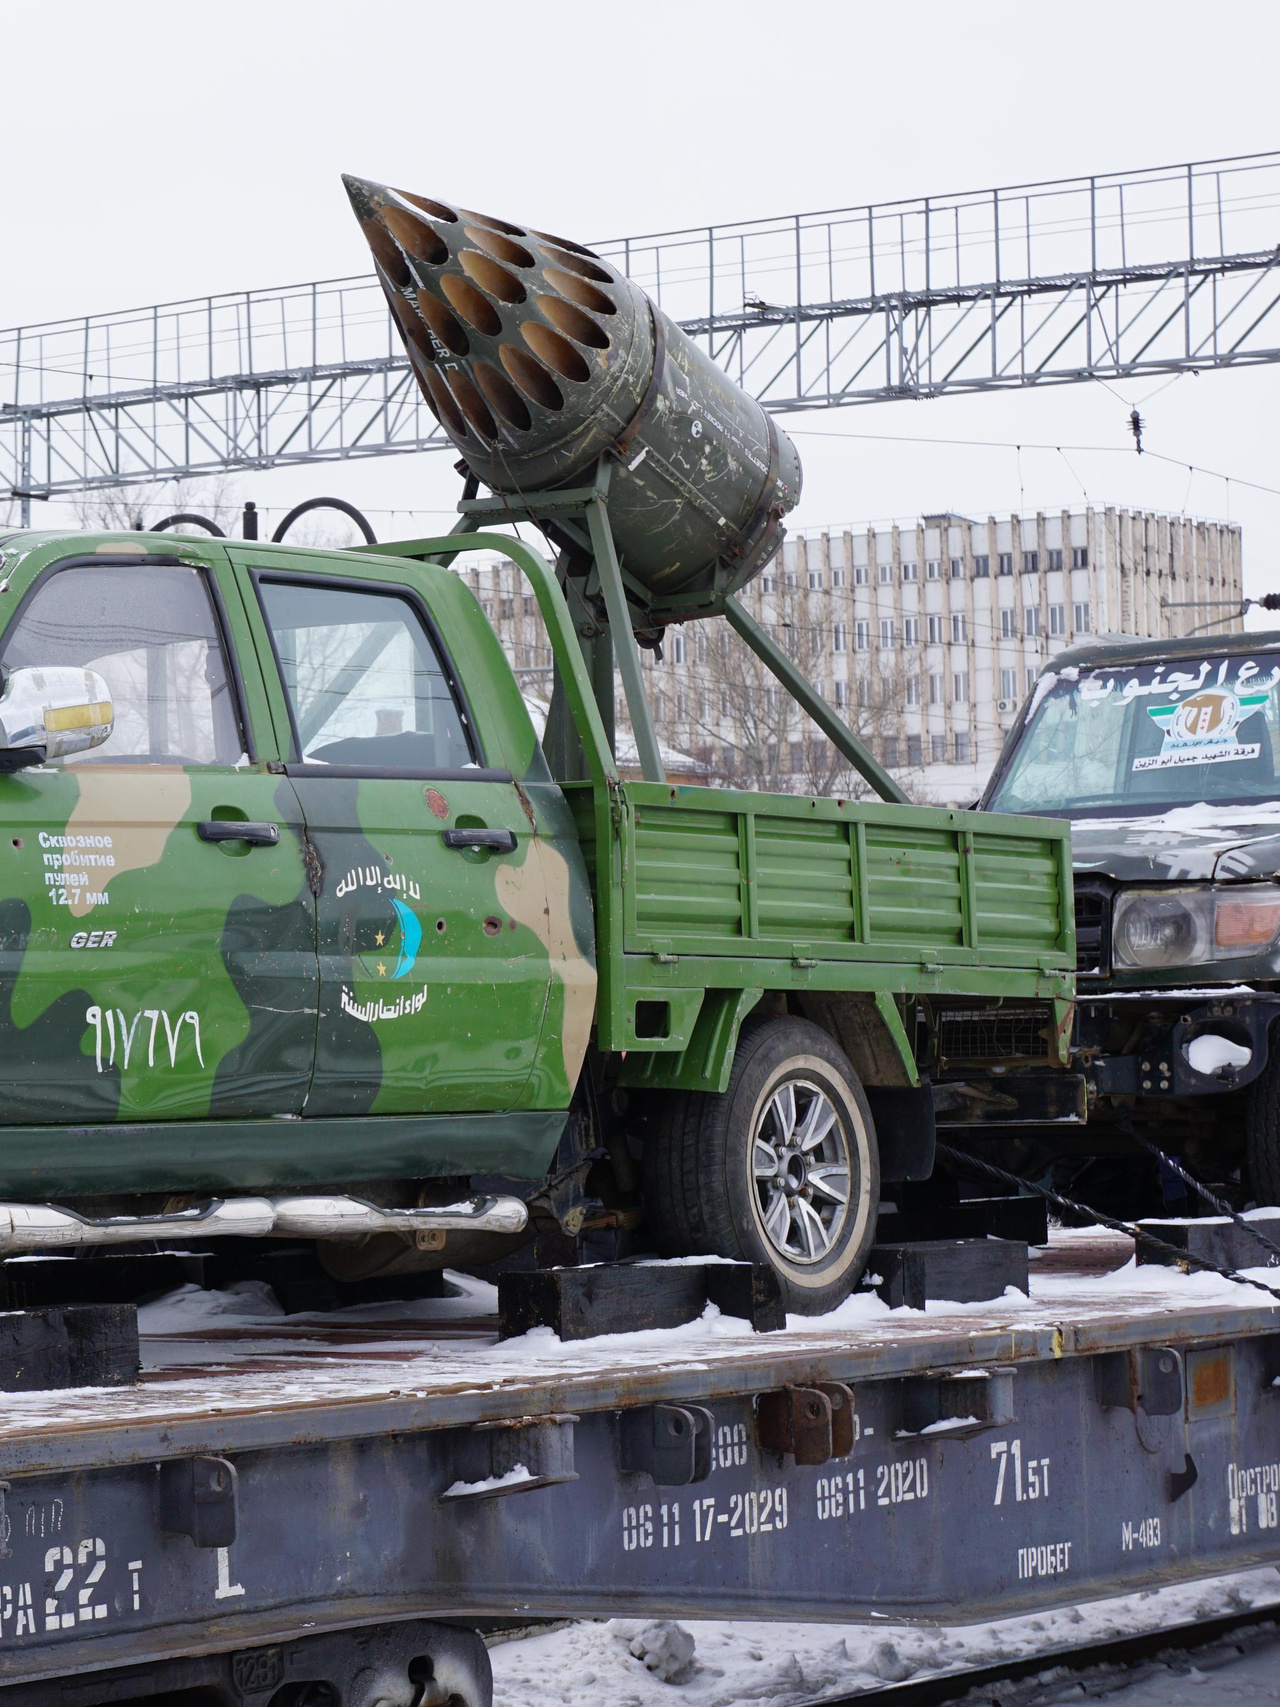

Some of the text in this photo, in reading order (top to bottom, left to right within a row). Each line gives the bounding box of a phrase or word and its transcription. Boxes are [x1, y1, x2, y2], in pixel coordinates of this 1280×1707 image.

[400, 287, 450, 358] MARHER
[38, 831, 113, 848] Сквозное
[43, 850, 116, 870] пробитие
[44, 872, 89, 887] пулей
[336, 866, 363, 898] الله
[49, 888, 81, 905] 12.7
[877, 1457, 929, 1506] 2020
[1018, 1541, 1071, 1579] ПРОБЕГ
[44, 1537, 108, 1631] 22
